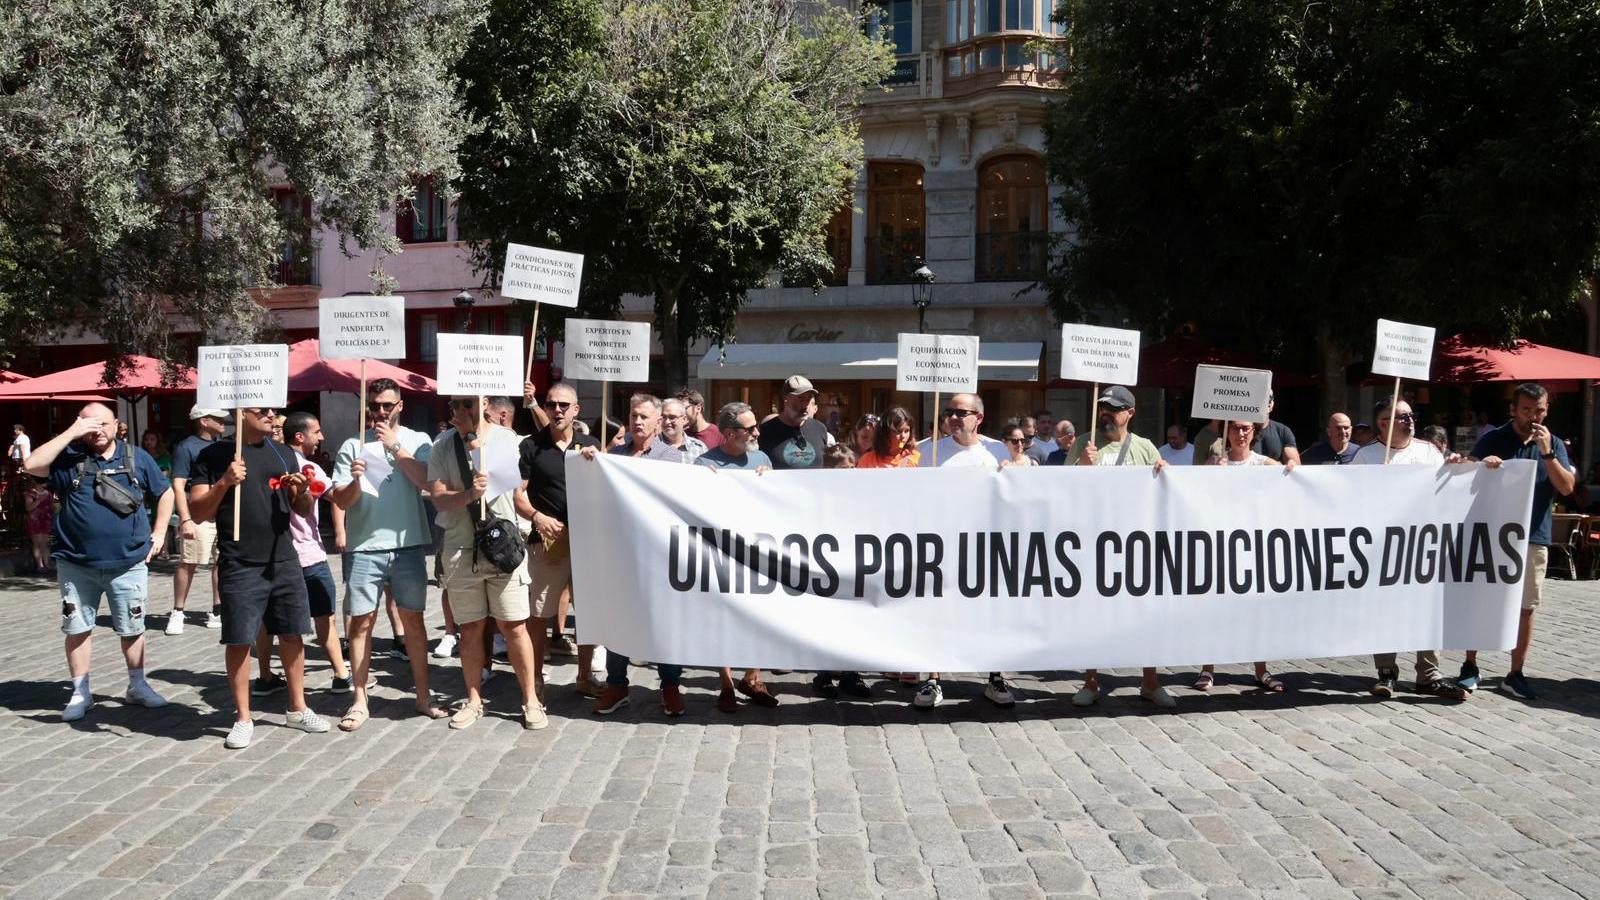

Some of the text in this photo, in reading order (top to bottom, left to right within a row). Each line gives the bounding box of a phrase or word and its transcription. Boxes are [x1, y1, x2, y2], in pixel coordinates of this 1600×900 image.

[515, 254, 563, 266] CONDICIONES
[511, 261, 575, 279] PRÁCTICAS JUSTAS
[544, 285, 573, 295] ABUSOS!
[788, 322, 844, 342] Cartier
[336, 338, 369, 346] POLICÍAS
[1101, 339, 1132, 347] JEFATURA
[1083, 361, 1118, 370] AMARGURA
[1219, 375, 1248, 383] MUCHA
[1213, 389, 1250, 397] PROMESA
[1210, 403, 1260, 413] RESULTADOS
[669, 522, 1524, 598] UNIDOS POR UNAS CONDICIONES DIGNAS
